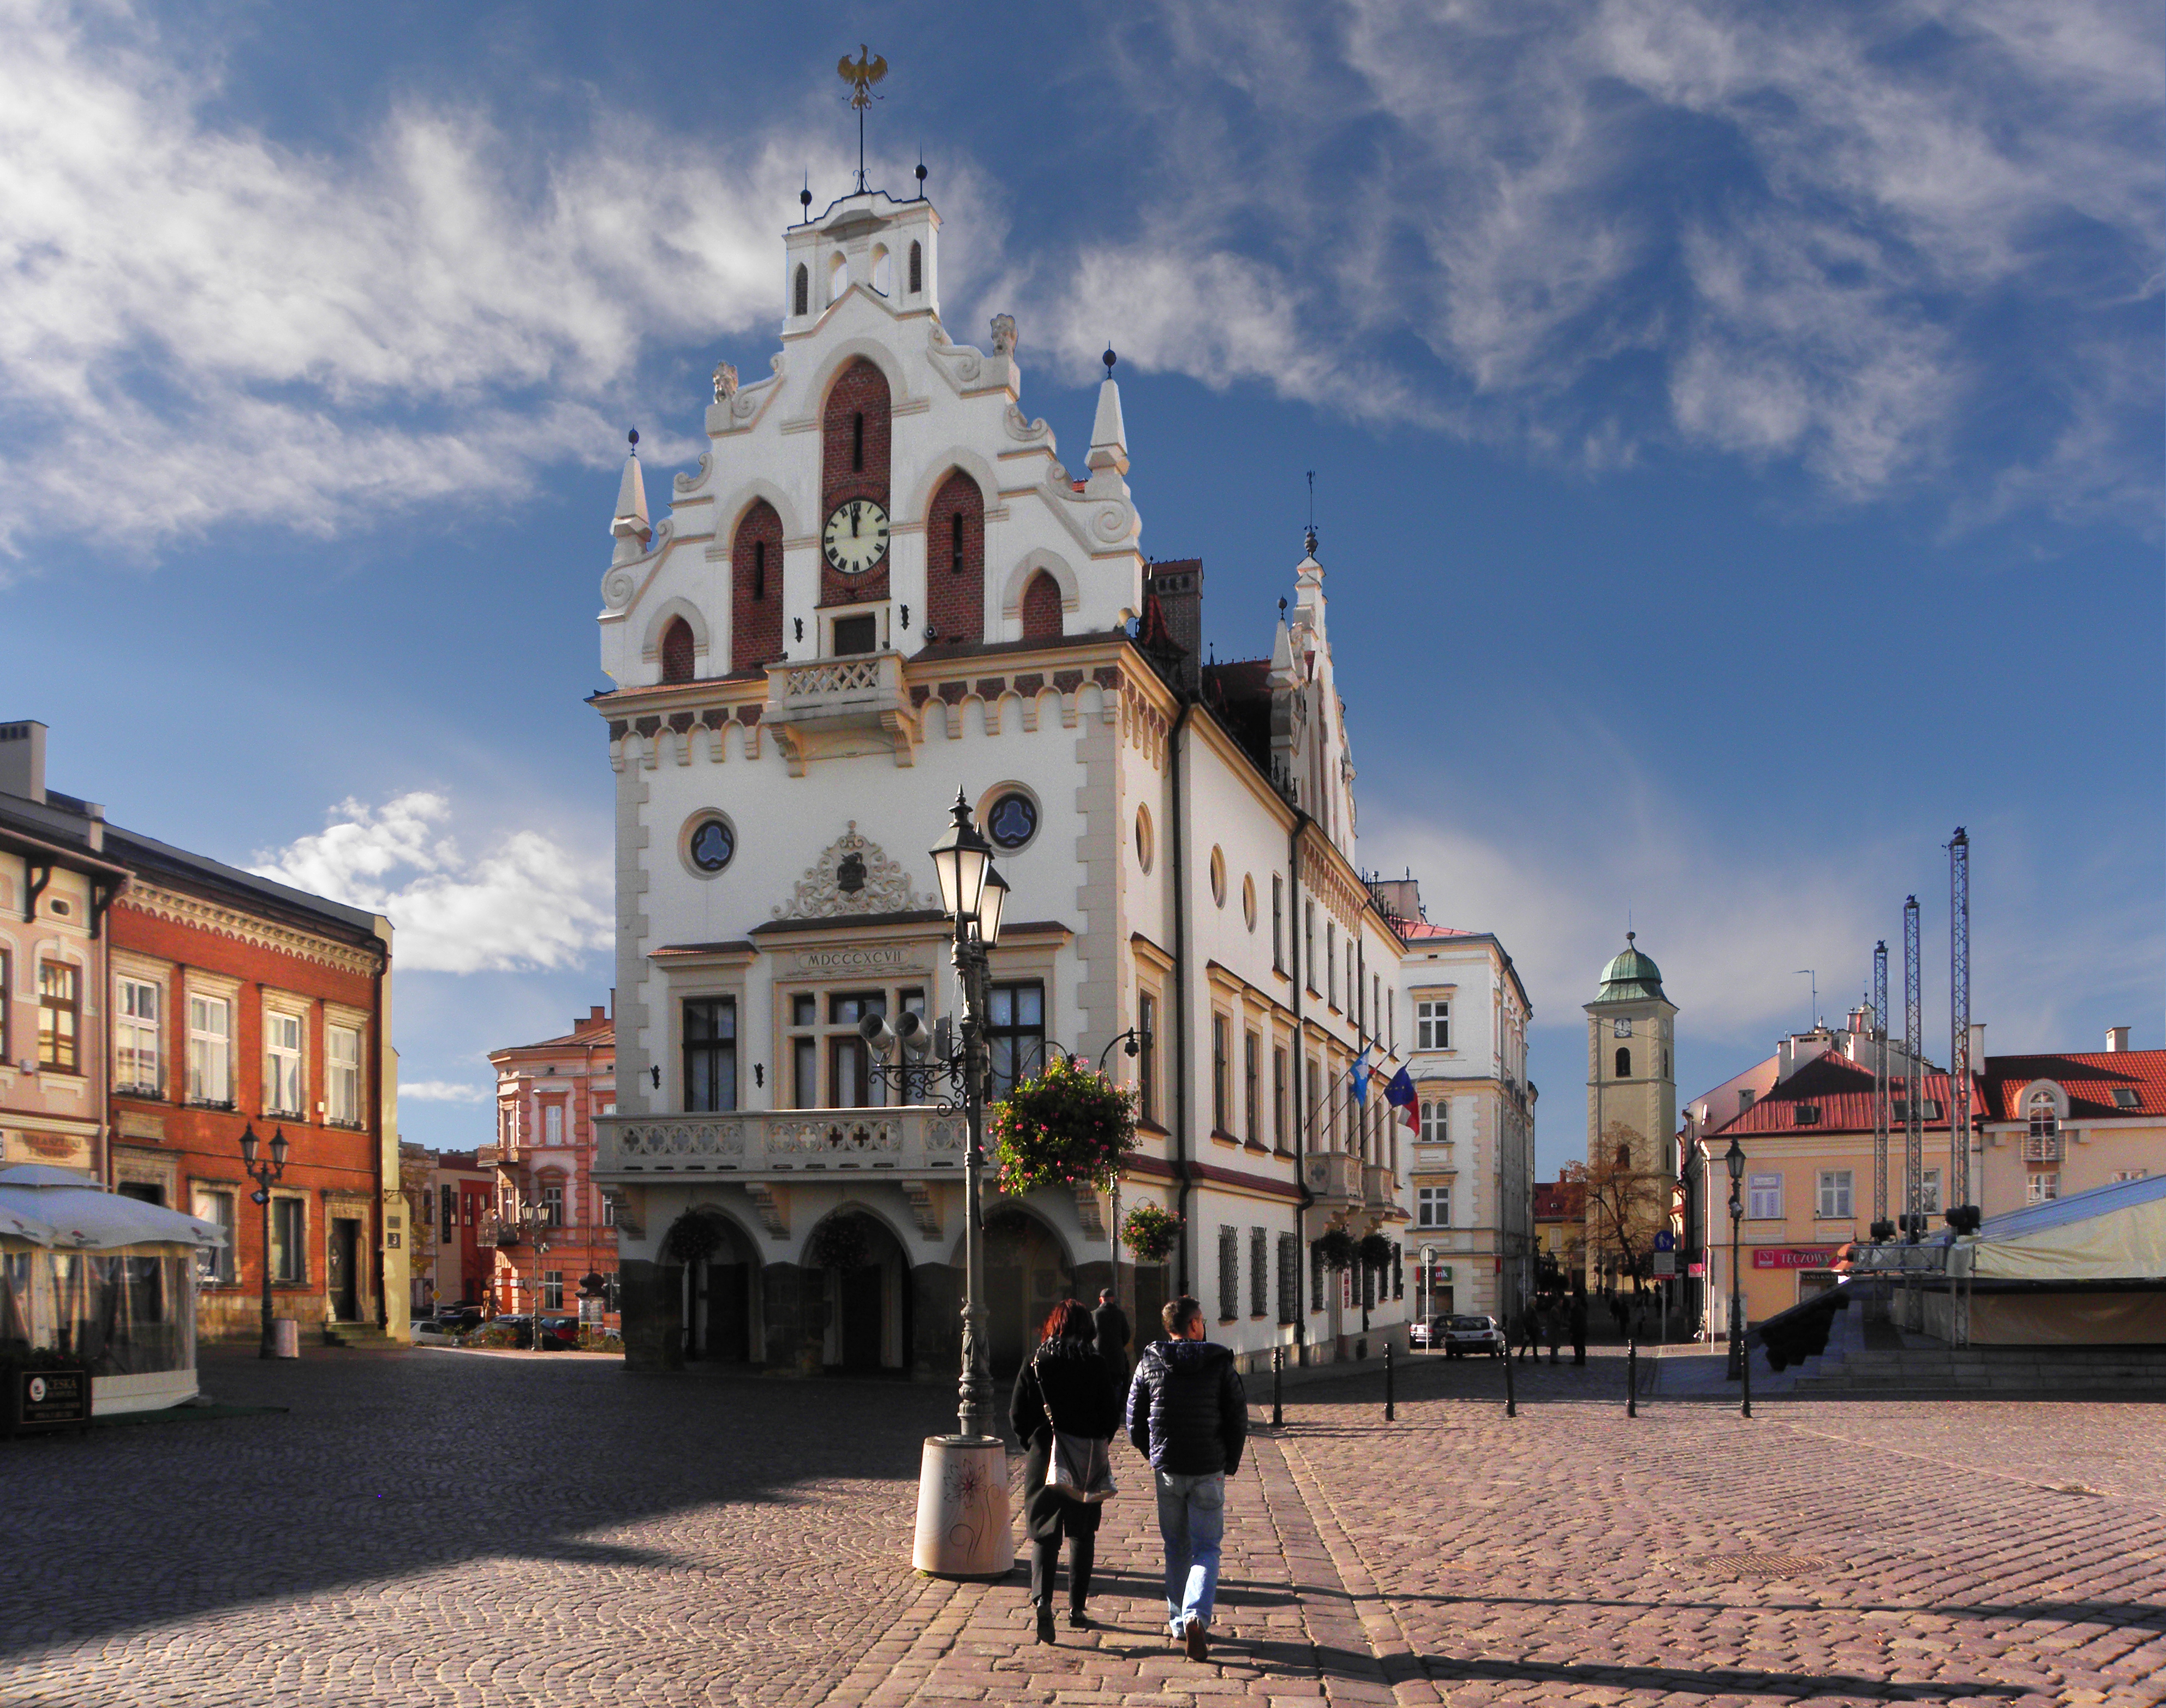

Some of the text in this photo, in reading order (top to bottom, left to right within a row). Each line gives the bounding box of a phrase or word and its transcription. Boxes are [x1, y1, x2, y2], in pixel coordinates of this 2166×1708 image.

[839, 507, 848, 519] XI
[867, 504, 873, 514] I
[875, 513, 884, 523] II
[829, 520, 838, 529] X
[825, 536, 834, 544] IX
[852, 560, 860, 571] VI
[866, 556, 874, 566] V
[808, 951, 900, 965] MDCCCXCVII
[392, 1234, 397, 1244] 3
[1780, 1253, 1829, 1265] TĘCZOWA
[46, 1376, 77, 1390] ČESKÁ
